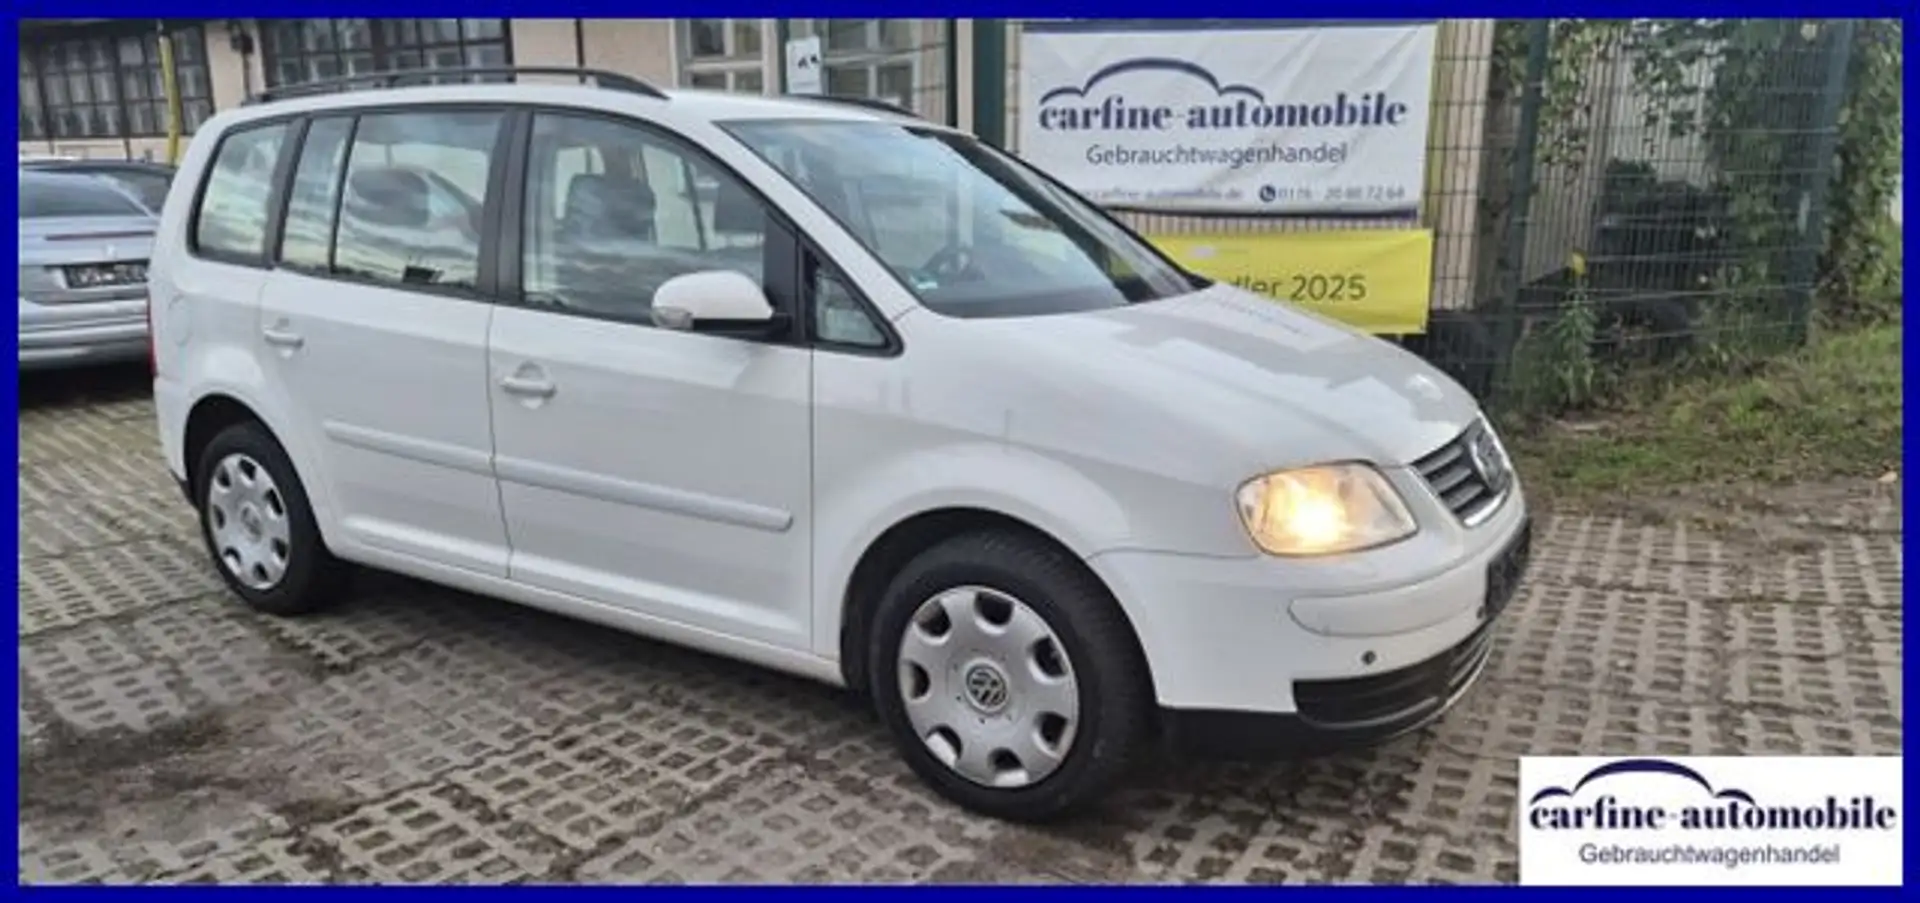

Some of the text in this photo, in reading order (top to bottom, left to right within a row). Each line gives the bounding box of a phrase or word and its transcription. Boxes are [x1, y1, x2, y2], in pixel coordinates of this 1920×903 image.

[1038, 92, 1407, 131] carfine-automobile
[1086, 143, 1347, 168] Gebrauchtwagenhandel
[1290, 274, 1366, 301] 2025
